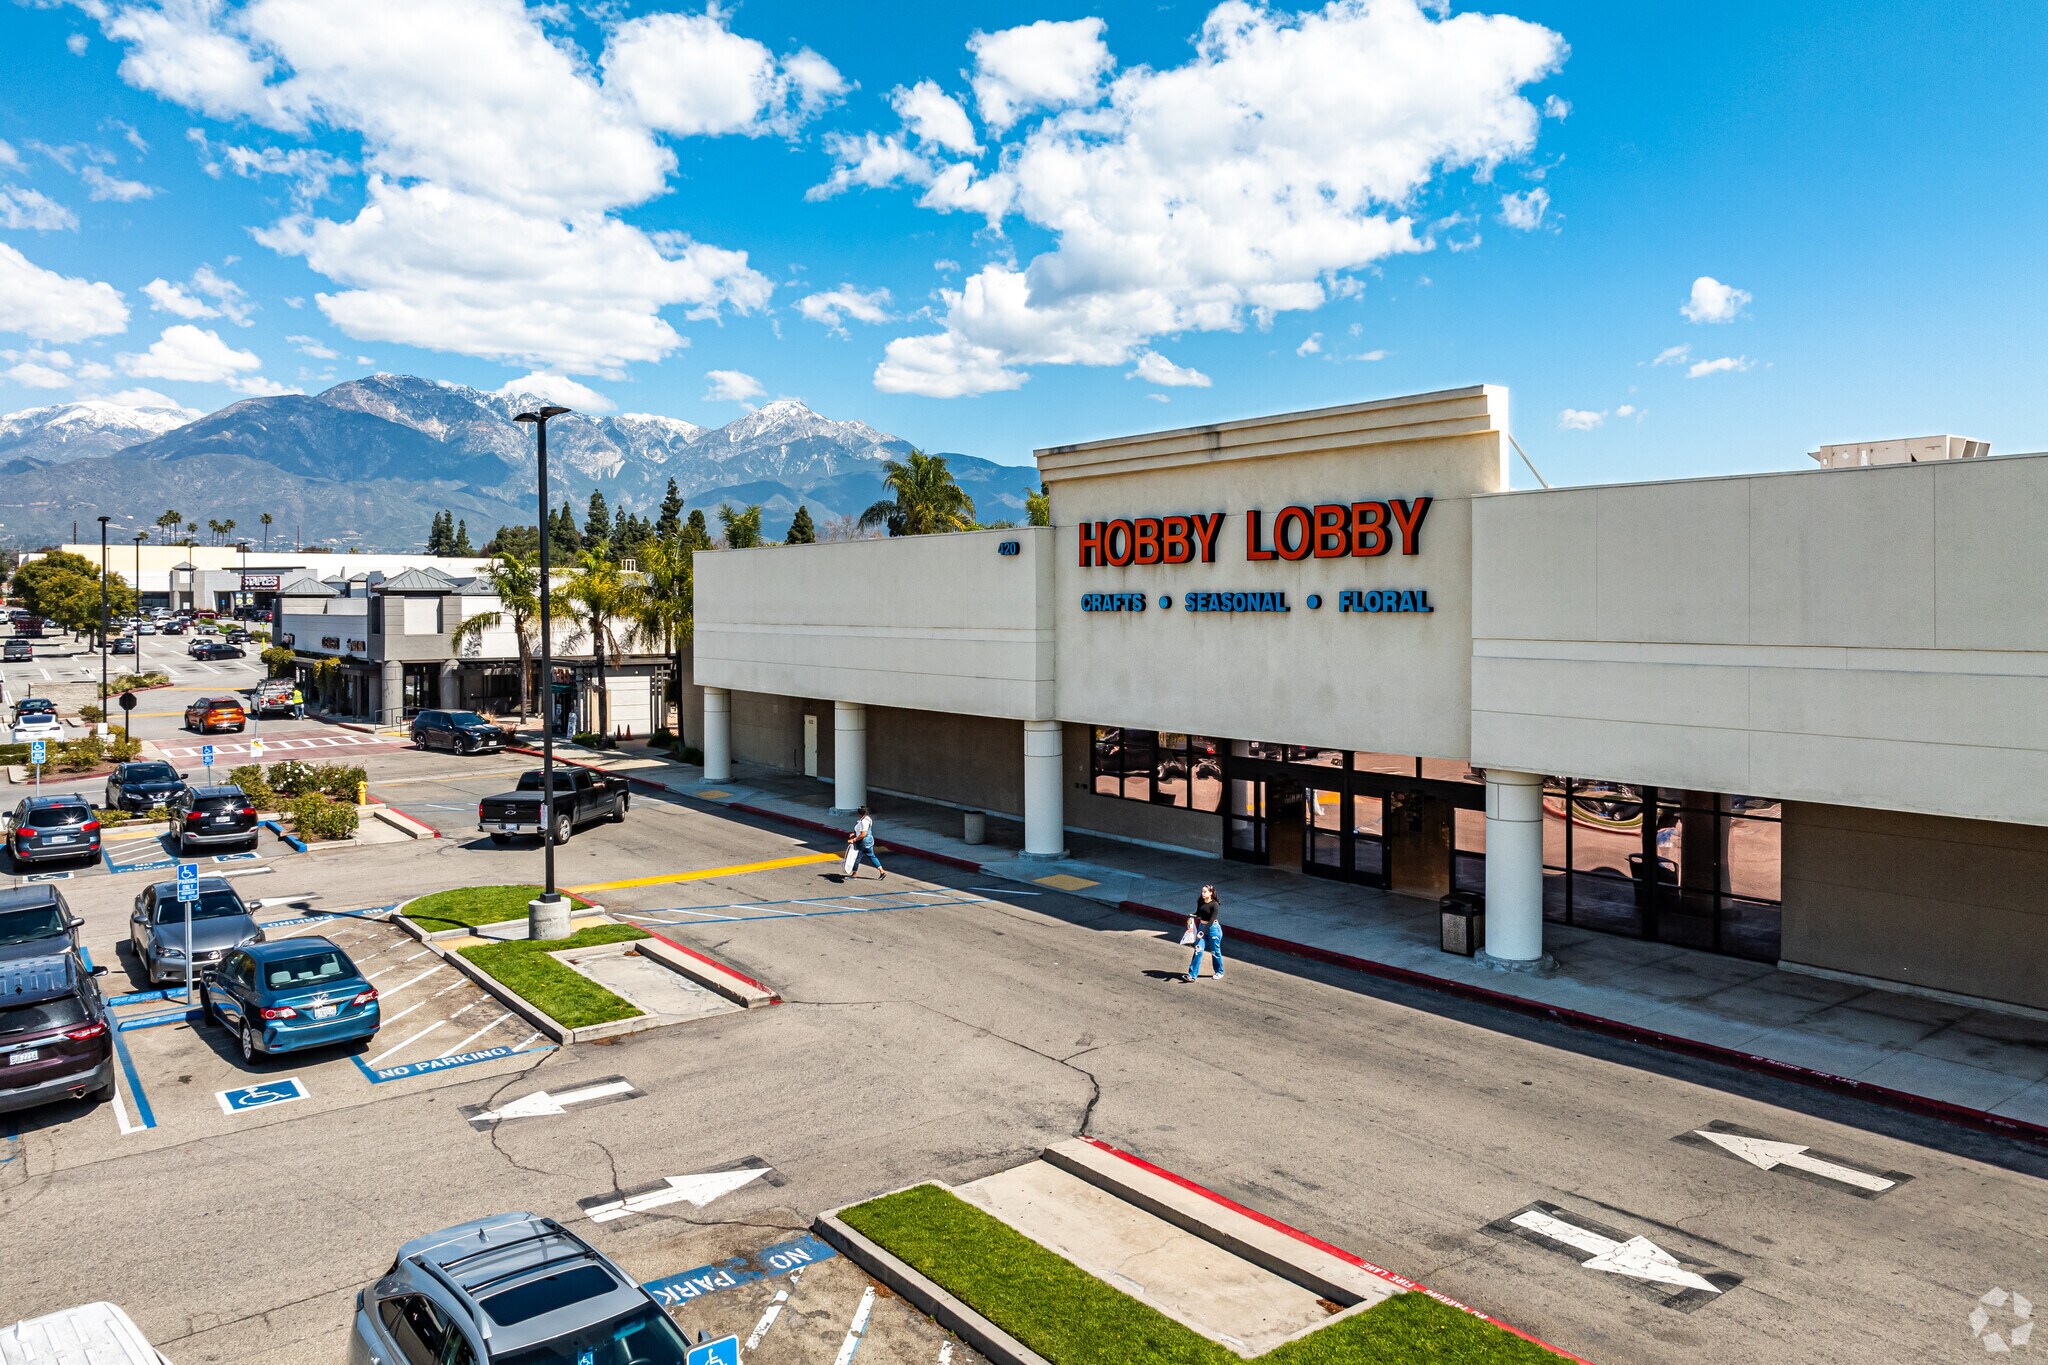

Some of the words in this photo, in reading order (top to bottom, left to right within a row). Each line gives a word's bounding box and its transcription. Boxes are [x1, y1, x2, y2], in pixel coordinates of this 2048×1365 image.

[1079, 513, 1226, 567] HOBBY
[1247, 497, 1433, 561] LOBBY
[998, 542, 1019, 555] 420
[1081, 593, 1146, 612] CRAFTS
[1185, 592, 1291, 612] SEASONAL
[1339, 590, 1434, 612] FLORAL
[267, 915, 335, 927] PARKING
[378, 1067, 409, 1079] NO
[415, 1047, 507, 1071] PARKING
[769, 1248, 813, 1269] NO
[1360, 1262, 1389, 1276] LANE
[1388, 1273, 1415, 1288] FIRE
[1423, 1289, 1468, 1311] PARKING
